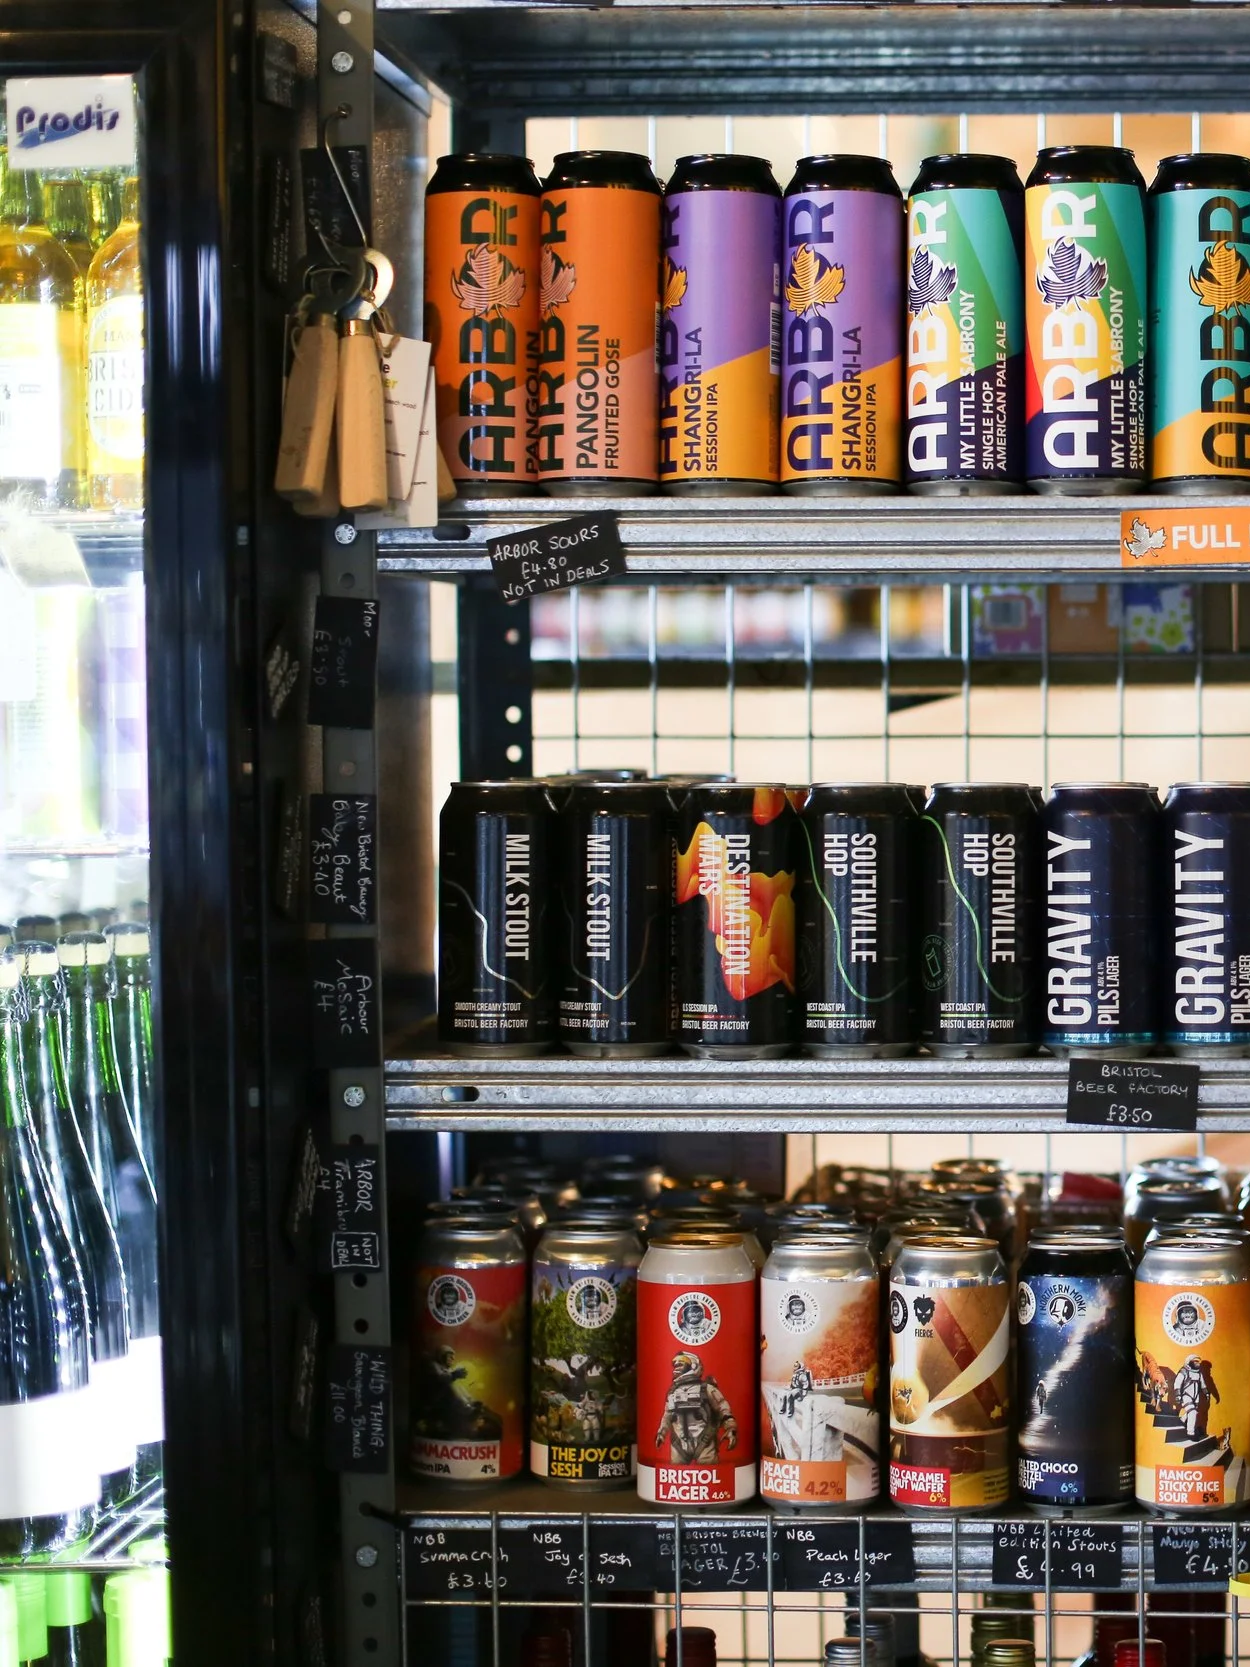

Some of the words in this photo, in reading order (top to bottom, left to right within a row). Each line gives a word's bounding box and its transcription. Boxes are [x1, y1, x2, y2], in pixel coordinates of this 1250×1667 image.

[960, 290, 975, 376] SABRONY
[997, 321, 1007, 349] ALE
[1111, 287, 1123, 375] SABRONY
[606, 338, 620, 387] GOSE
[997, 354, 1007, 393] PALE
[576, 324, 599, 469] PANGOLIN
[684, 327, 702, 471] SHANGRI-LA
[706, 383, 718, 407] IPA
[842, 326, 862, 471] SHANGRI-LA
[866, 383, 876, 407] IPA
[960, 382, 975, 436] LITTLE
[983, 381, 994, 409] HOP
[1112, 379, 1124, 435] LITTLE
[605, 393, 619, 470] FRUITED
[706, 412, 718, 472] SESSION
[866, 411, 876, 472] SESSION
[983, 415, 994, 471] SINGLE
[997, 400, 1007, 471] AMERICAN
[960, 442, 975, 470] MY
[1112, 441, 1124, 469] MY
[493, 540, 542, 561] ARBOR
[549, 525, 599, 550] SOURS
[1172, 524, 1240, 549] FULL
[503, 580, 536, 599] NOT
[544, 574, 560, 589] IN
[566, 559, 610, 583] DEALS
[521, 556, 567, 579] £4.80
[363, 602, 376, 637] Moor
[321, 800, 350, 848] Baby
[311, 840, 332, 896] £3.40
[357, 834, 372, 872] Bristol
[506, 834, 530, 887] MILK
[586, 834, 611, 887] MILK
[699, 835, 722, 896] MARS
[824, 833, 848, 877] HOP
[963, 833, 988, 877] HOP
[332, 854, 352, 904] Beaut
[725, 834, 750, 975] DESTINATION
[851, 833, 877, 963] SOUTHVILLE
[991, 833, 1016, 963] SOUTHVILLE
[505, 893, 530, 961] STOUT
[586, 893, 611, 961] STOUT
[1047, 830, 1092, 1025] GRAVITY
[1175, 829, 1224, 1025] GRAVITY
[1106, 955, 1120, 988] LAGER
[313, 980, 335, 1012] £4
[355, 975, 372, 1034] Arbour
[1097, 989, 1120, 1025] PILS
[454, 1018, 479, 1028] BRISTOL
[480, 1019, 498, 1028] BEER
[499, 1019, 528, 1029] FACTORY
[940, 1019, 965, 1029] BRISTOL
[967, 1020, 984, 1030] BEER
[986, 1020, 1015, 1030] FACTORY
[1101, 1065, 1162, 1080] BRISTOL
[1075, 1082, 1117, 1094] BEER
[1128, 1082, 1188, 1098] FACTORY
[1106, 1103, 1153, 1123] £3.50
[354, 1159, 376, 1213] ARBOR
[335, 1240, 349, 1266] DEAL
[352, 1244, 360, 1257] IN
[361, 1238, 373, 1265] NOT
[914, 1328, 933, 1339] FIERCE
[369, 1360, 388, 1395] WILD
[369, 1401, 385, 1448] THING
[550, 1463, 582, 1478] SESH
[551, 1446, 576, 1461] THE
[576, 1446, 607, 1462] JOY
[609, 1445, 629, 1460] OF
[763, 1460, 800, 1480] PEACH
[659, 1469, 721, 1484] BRISTOL
[762, 1474, 800, 1496] LAGER
[804, 1480, 843, 1496] 4.2%
[900, 1470, 947, 1484] CARAMEL
[910, 1481, 945, 1493] WAFER
[1060, 1481, 1078, 1493] 6%
[1158, 1481, 1195, 1493] STICKY
[1196, 1481, 1220, 1492] RICE
[1159, 1469, 1203, 1481] MANGO
[929, 1492, 947, 1503] 6%
[1158, 1491, 1188, 1504] SOUR
[1202, 1491, 1219, 1504] 5%
[414, 1532, 446, 1545] NBB
[533, 1532, 562, 1544] NBB
[786, 1529, 815, 1542] NBB
[1160, 1537, 1200, 1554] Mango
[545, 1549, 571, 1566] Joy
[600, 1552, 632, 1567] Sesh
[806, 1549, 848, 1562] Peach
[853, 1549, 892, 1565] Lger
